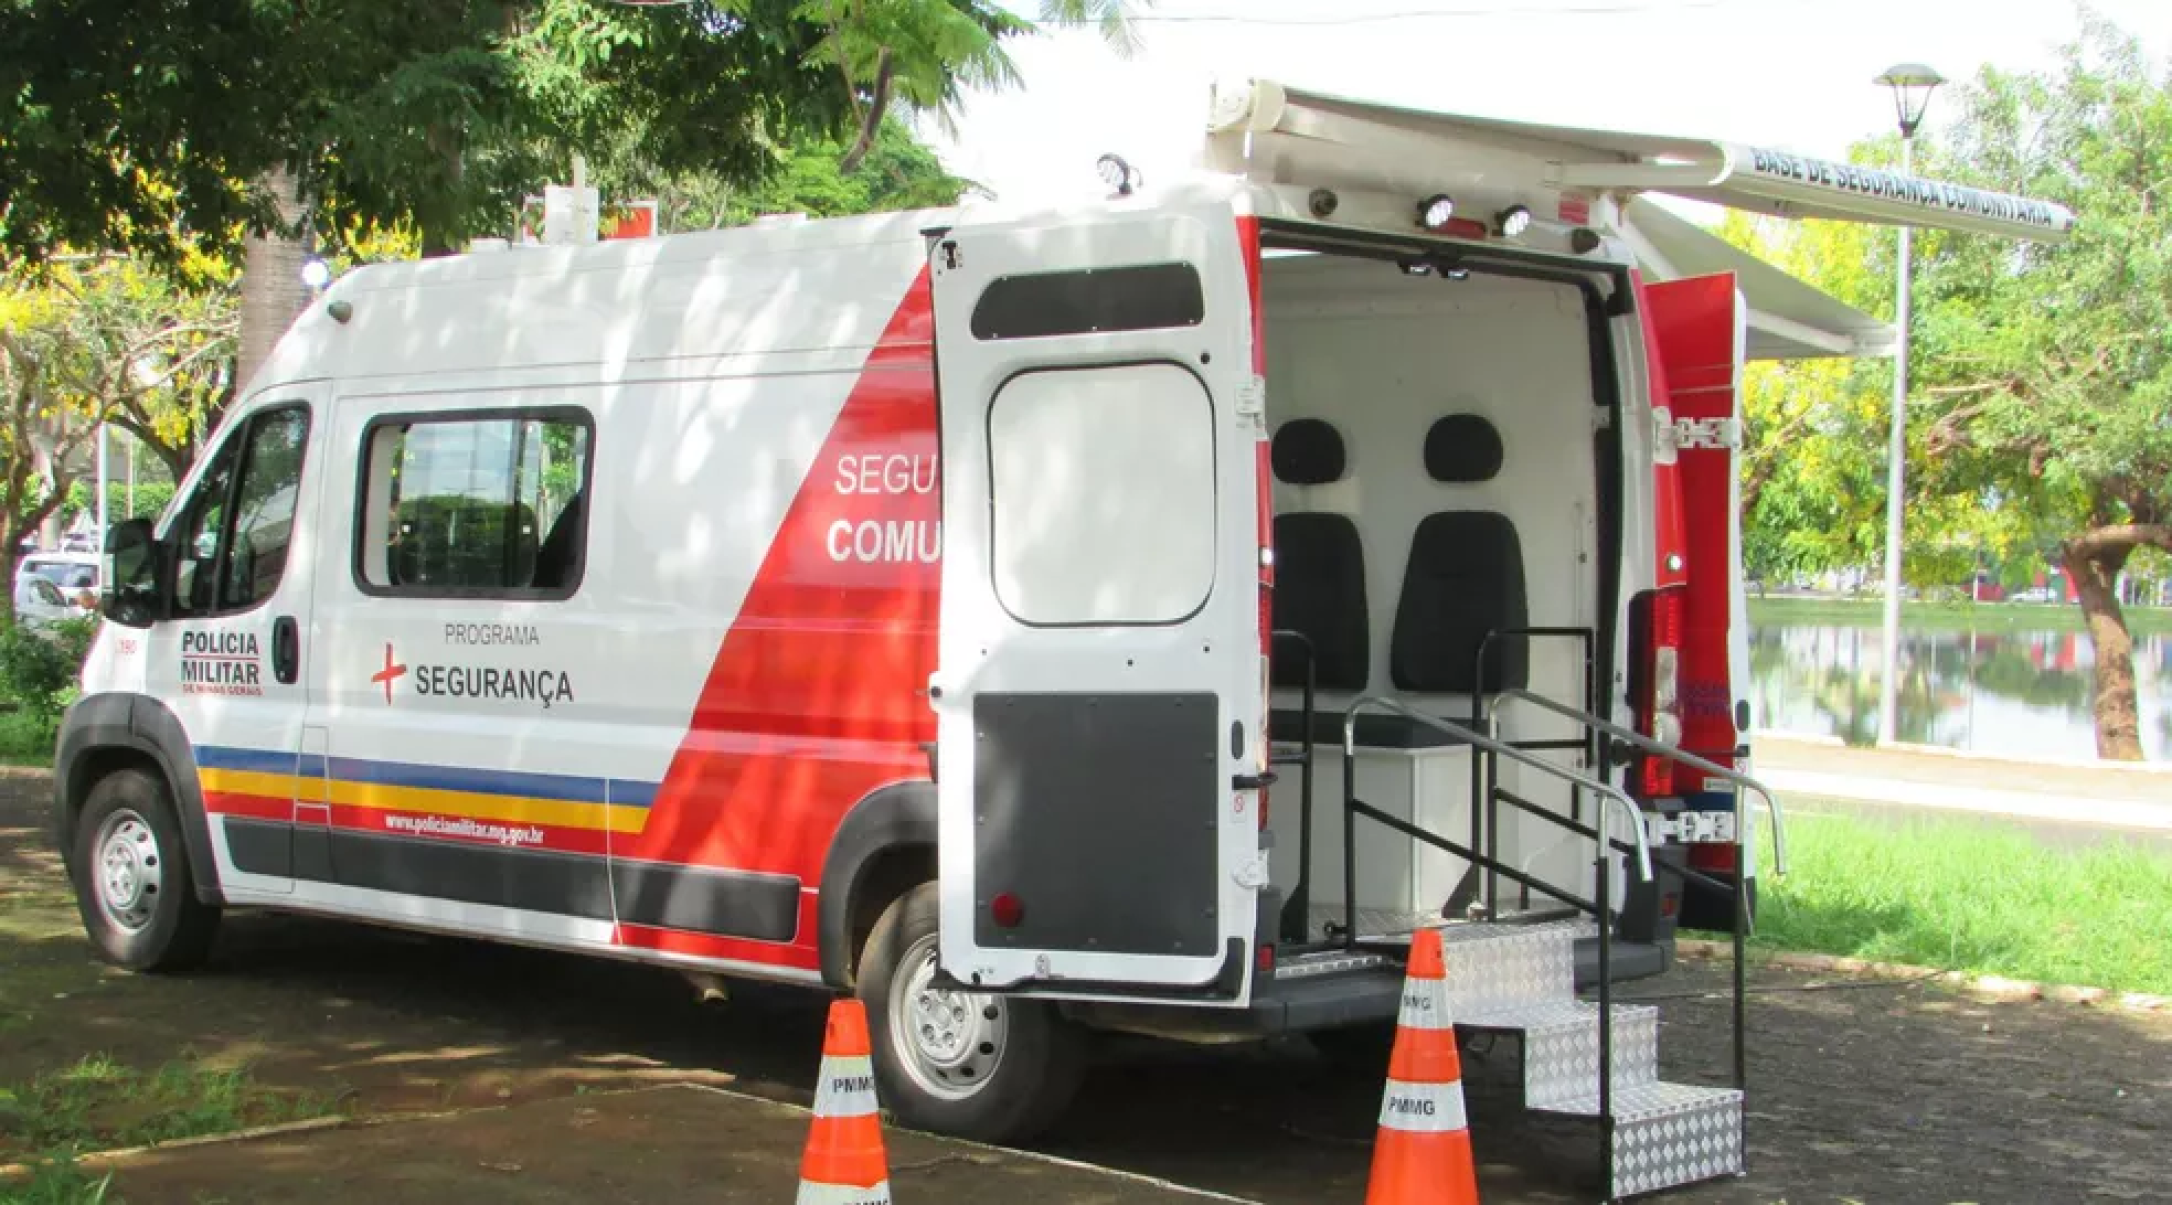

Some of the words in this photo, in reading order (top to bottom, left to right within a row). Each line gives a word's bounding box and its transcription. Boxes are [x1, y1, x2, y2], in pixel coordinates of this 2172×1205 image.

[1750, 147, 1802, 179] BASE
[1806, 159, 1831, 185] DE
[834, 454, 937, 494] SEGU
[826, 519, 941, 563] COMU
[182, 628, 259, 655] POLÍCIA
[445, 623, 540, 646] PROGRAMA
[181, 660, 260, 684] MILITAR
[416, 665, 575, 709] SEGURANÇA
[1388, 1096, 1435, 1116] PMMG
